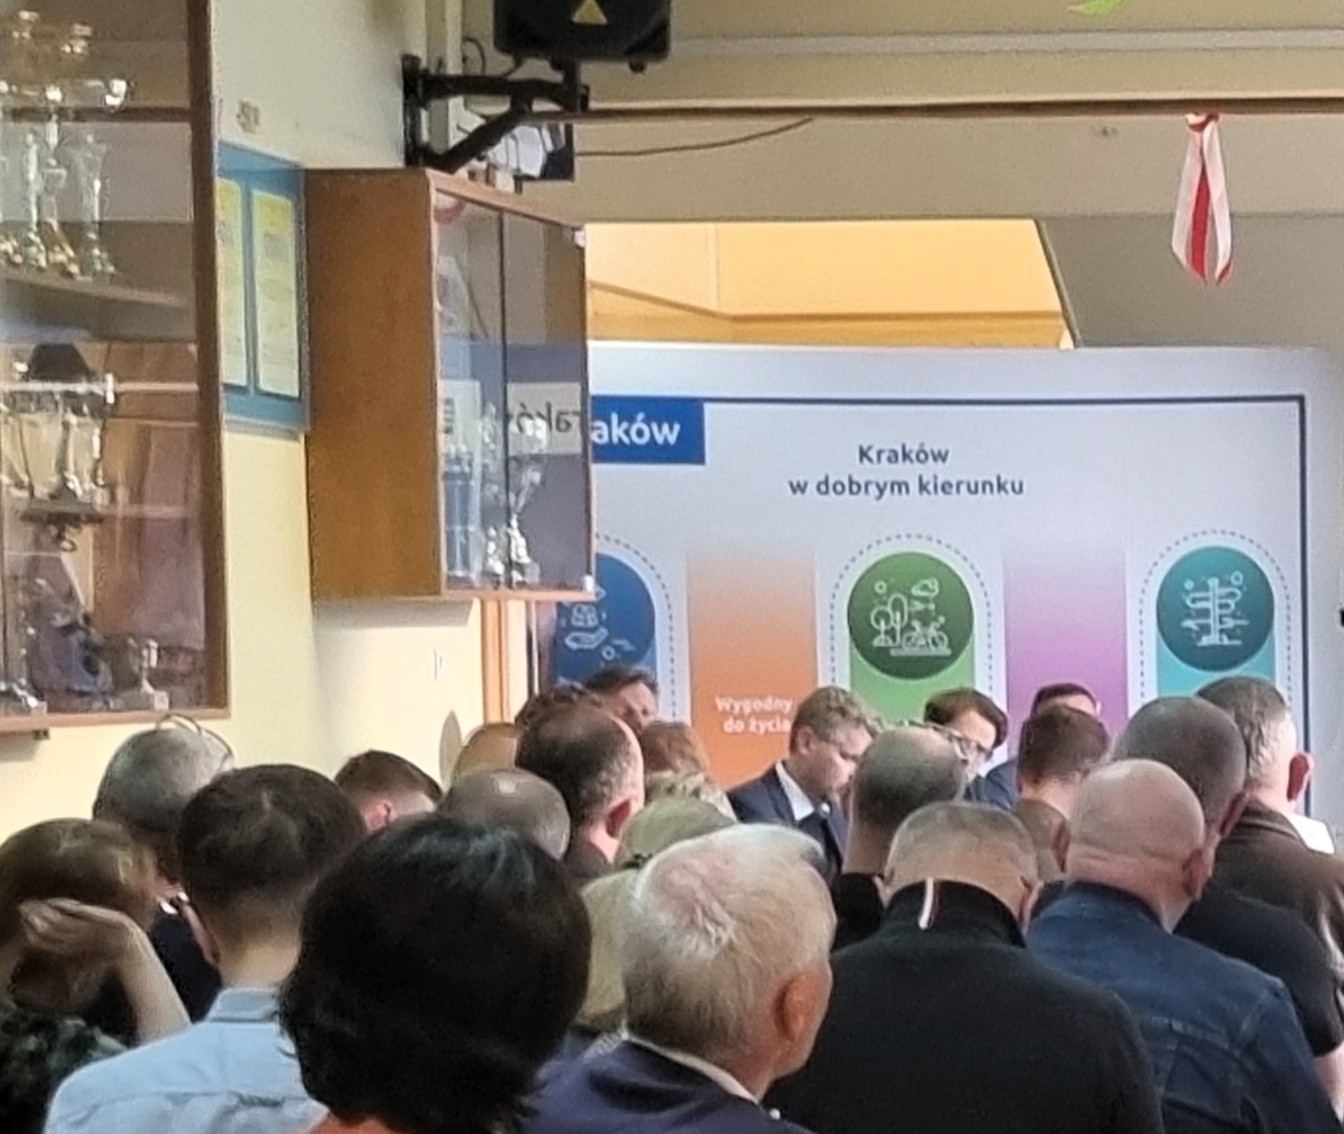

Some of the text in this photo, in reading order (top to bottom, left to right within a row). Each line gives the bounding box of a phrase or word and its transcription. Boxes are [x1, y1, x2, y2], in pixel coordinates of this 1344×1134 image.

[591, 412, 680, 446] aków
[857, 442, 950, 465] Kraków
[788, 474, 1025, 501] w dobrym kierunku
[714, 694, 794, 715] Wygodny
[722, 715, 746, 734] do
